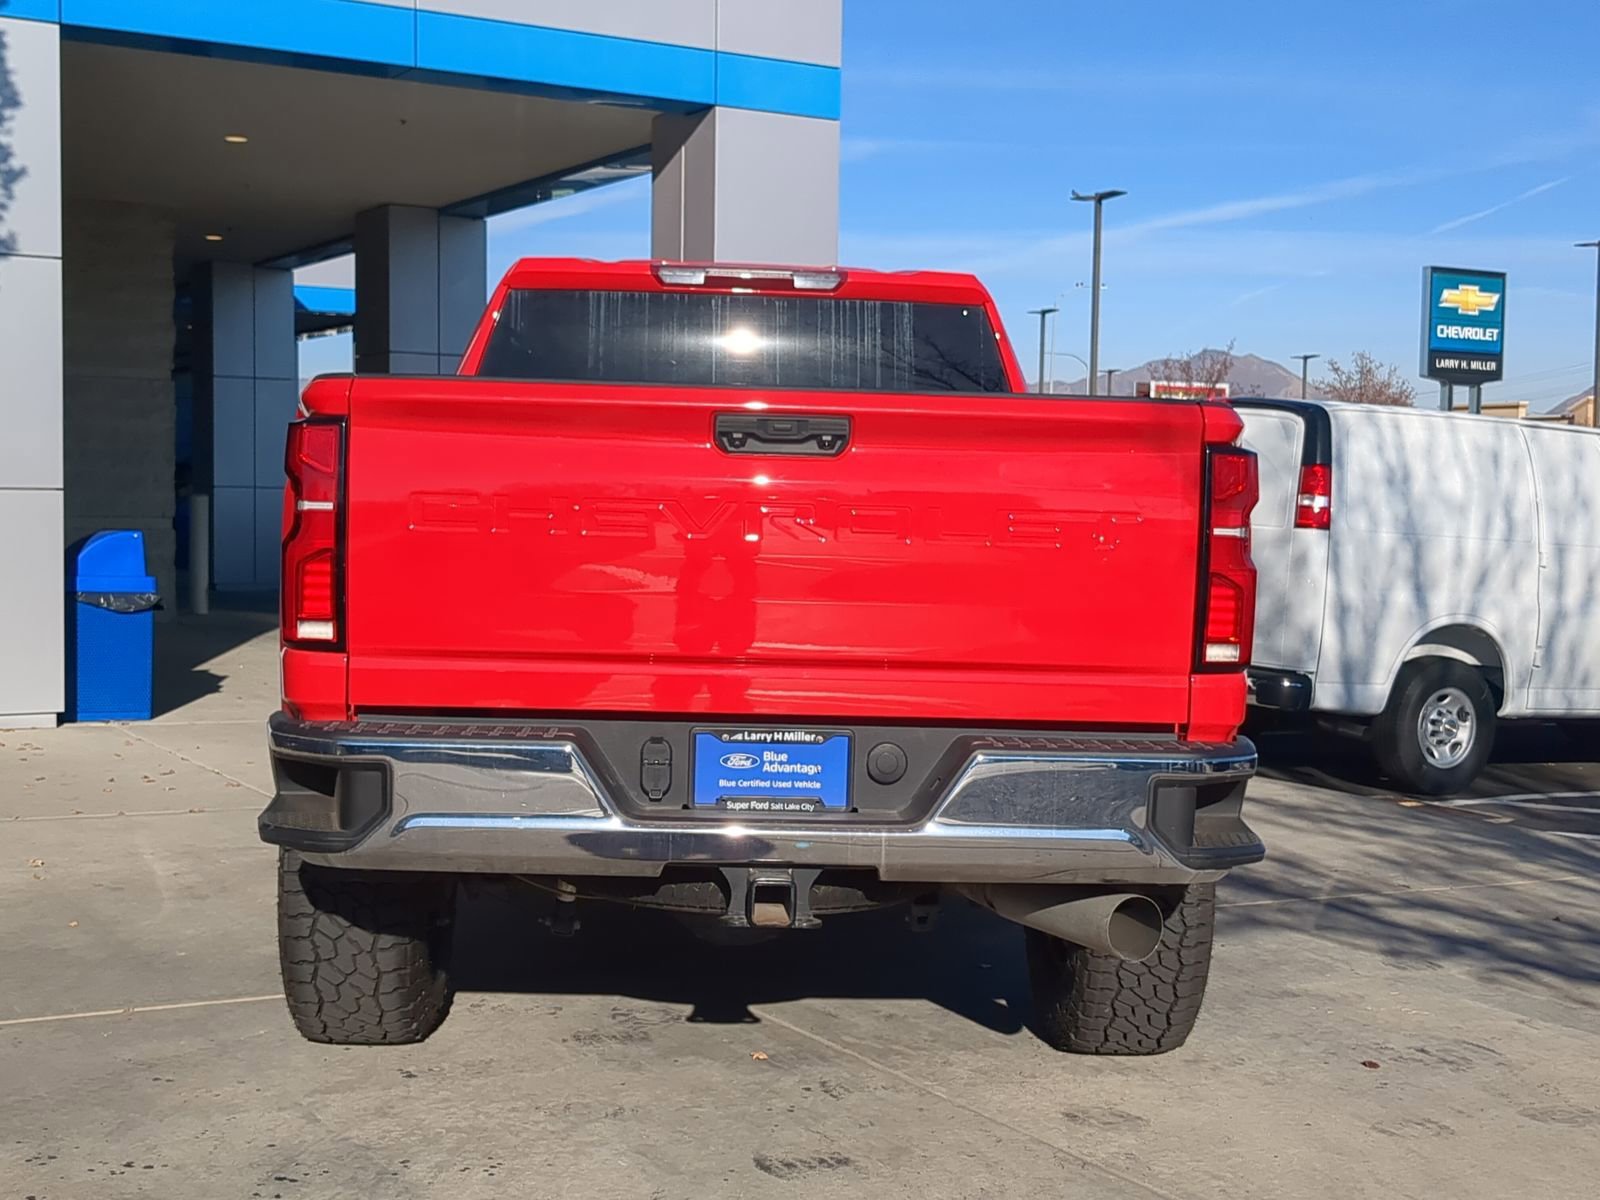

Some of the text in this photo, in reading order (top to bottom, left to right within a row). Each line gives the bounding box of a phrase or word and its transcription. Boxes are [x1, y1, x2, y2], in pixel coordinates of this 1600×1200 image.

[1437, 325, 1499, 341] CHEVROLET
[1436, 358, 1459, 369] LARRY
[1471, 360, 1496, 371] MILLER
[408, 491, 1145, 551] CHEVROLET
[744, 731, 816, 743] Larry H Miller
[727, 755, 753, 767] Ford
[763, 751, 788, 762] Blue
[762, 763, 822, 775] Advantage
[718, 779, 821, 789] Blue Certified Used Vehicle
[726, 801, 815, 812] Super Ford Salt Lake City
